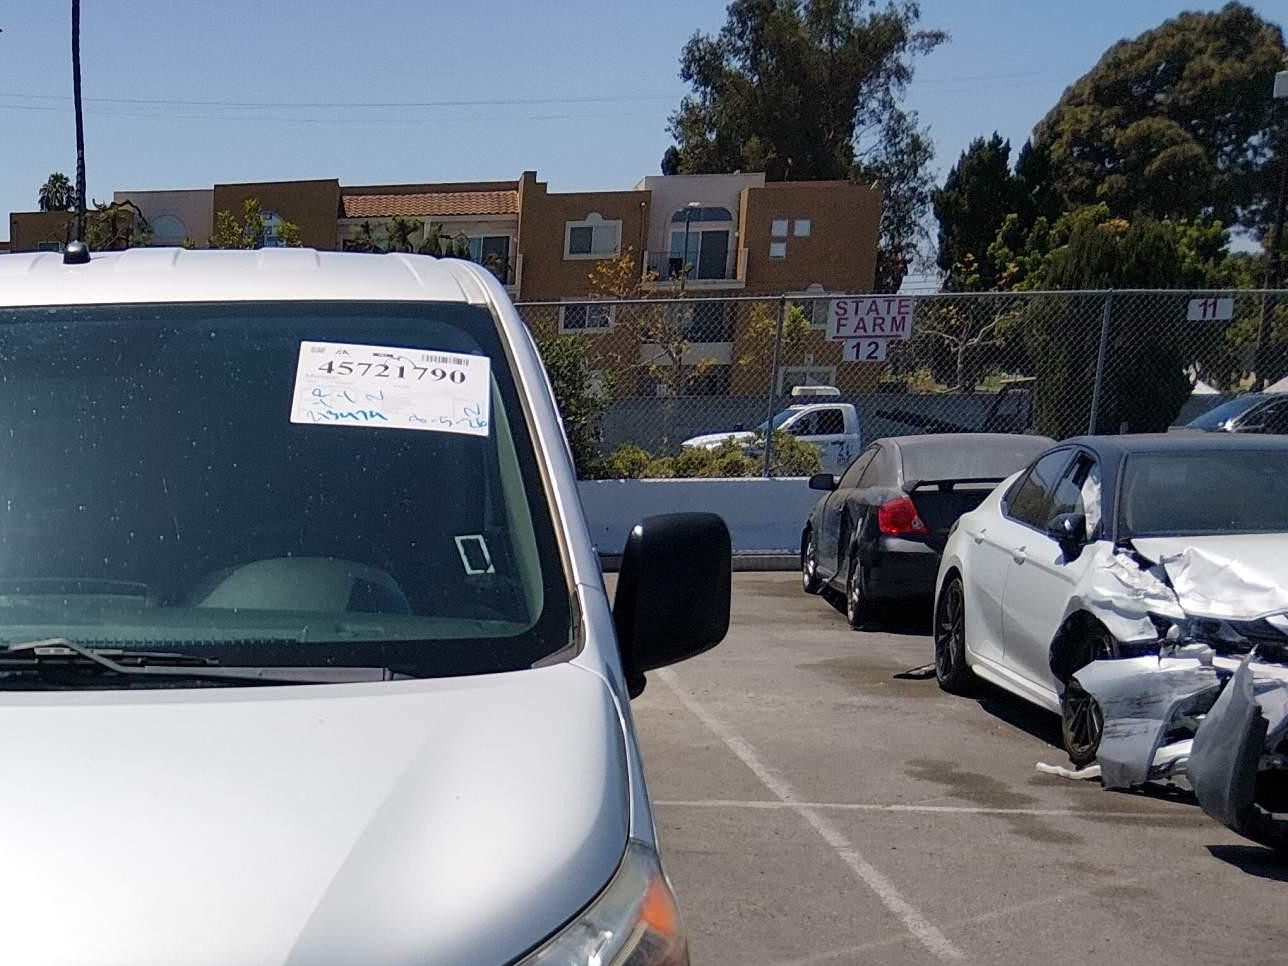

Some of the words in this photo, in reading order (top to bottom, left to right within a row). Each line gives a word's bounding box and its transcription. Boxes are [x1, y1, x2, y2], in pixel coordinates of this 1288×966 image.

[834, 299, 911, 317] STATE
[1198, 298, 1218, 319] 11
[835, 316, 906, 334] FARM
[851, 341, 880, 360] 12
[318, 359, 466, 385] 45721790
